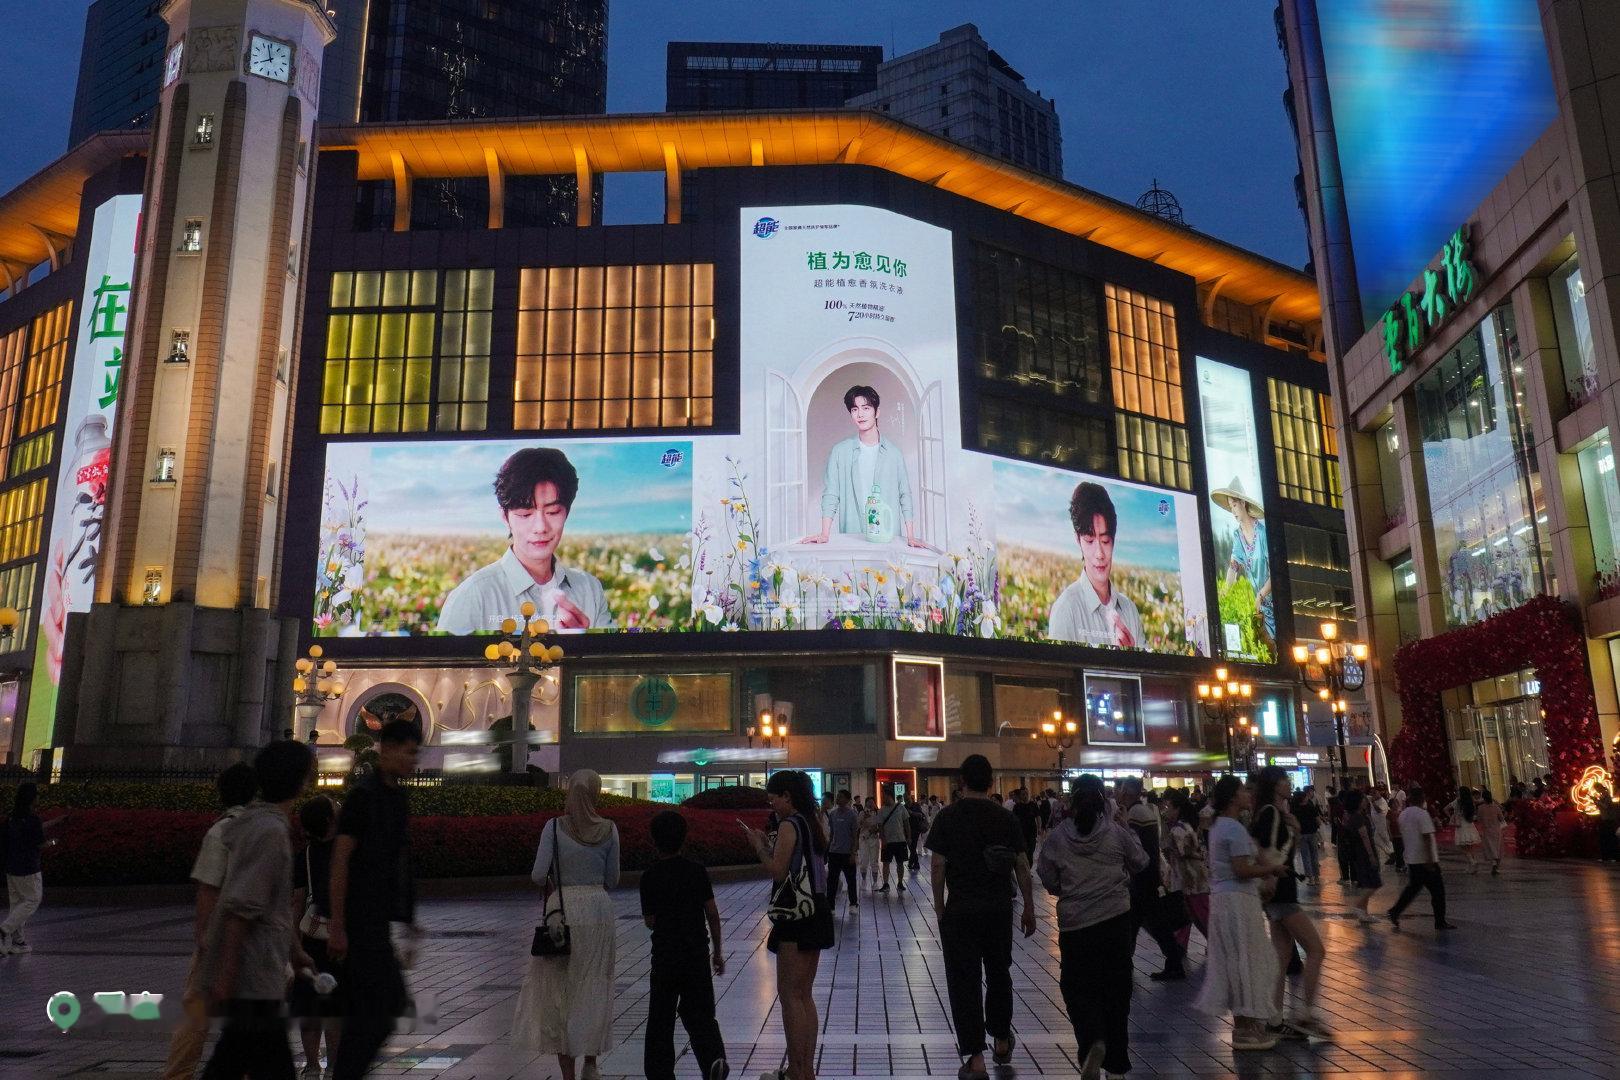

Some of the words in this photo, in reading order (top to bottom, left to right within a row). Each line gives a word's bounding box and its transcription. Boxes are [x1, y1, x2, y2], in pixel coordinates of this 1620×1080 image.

[753, 220, 780, 235] 超能
[813, 278, 904, 295] 超能植愈香氛洗衣液
